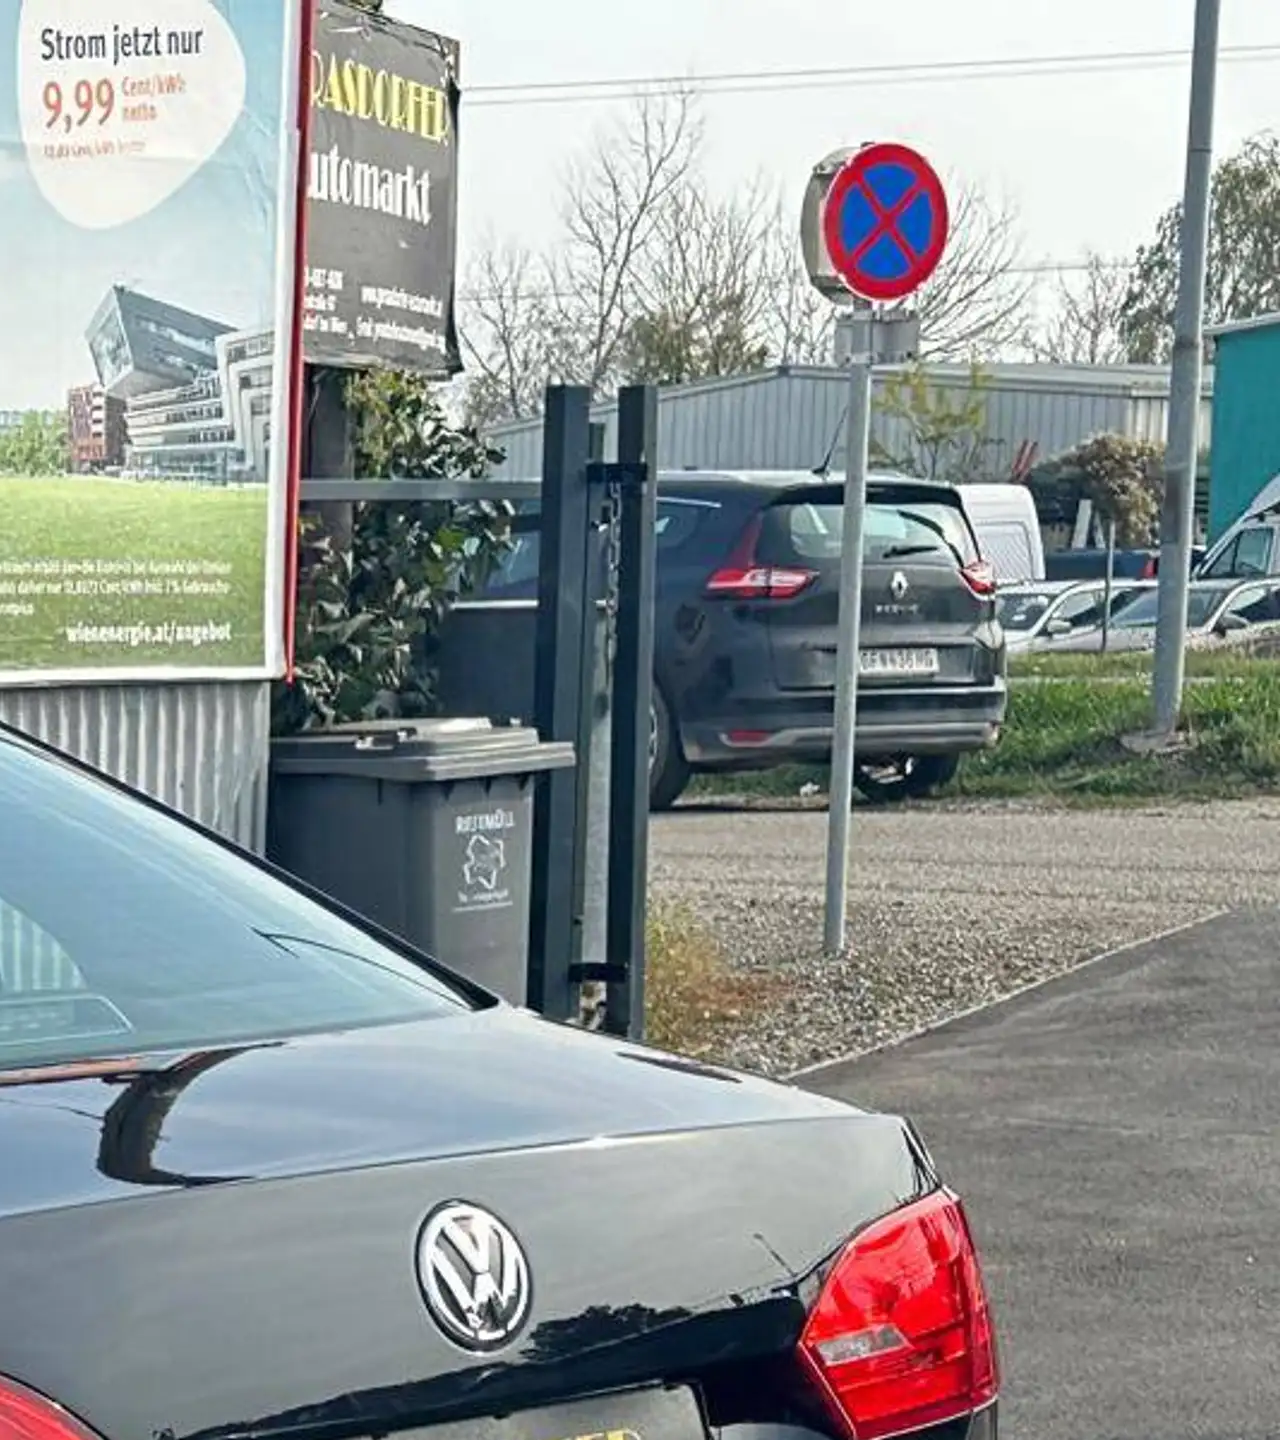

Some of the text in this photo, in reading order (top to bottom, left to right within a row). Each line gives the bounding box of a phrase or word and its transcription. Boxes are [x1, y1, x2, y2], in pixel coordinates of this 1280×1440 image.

[41, 25, 203, 65] Strom jetzt nur
[42, 78, 115, 134] 9,99
